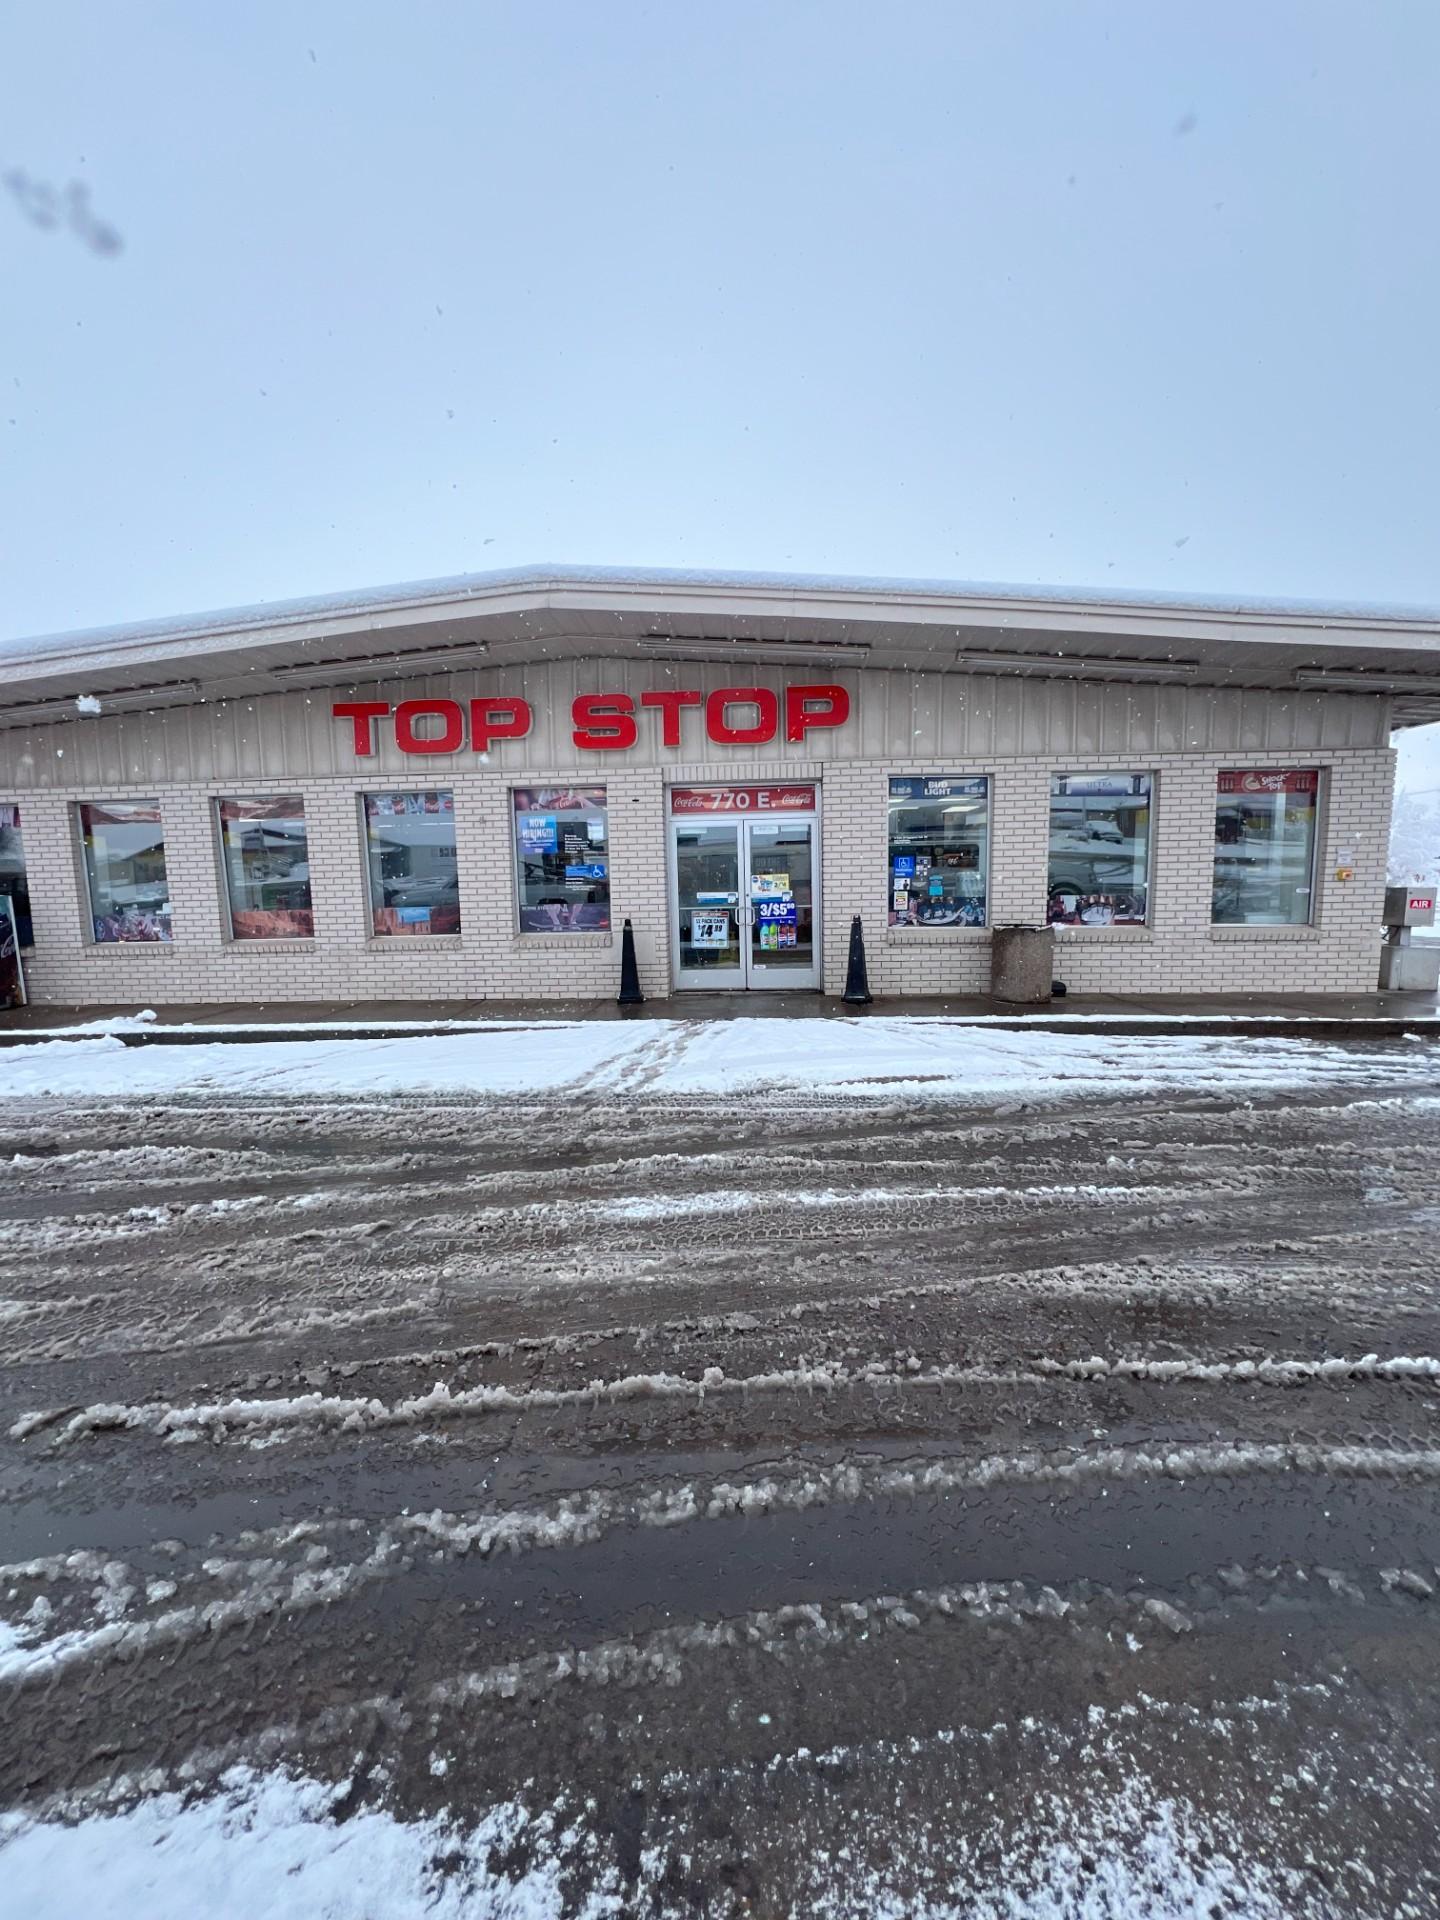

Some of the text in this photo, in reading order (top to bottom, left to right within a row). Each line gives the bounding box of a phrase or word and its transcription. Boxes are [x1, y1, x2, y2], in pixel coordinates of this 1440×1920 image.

[333, 685, 849, 756] TOP STOP
[924, 788, 952, 796] LIGHT
[711, 792, 750, 809] 770
[529, 818, 547, 828] NOW
[1411, 900, 1429, 908] AIR
